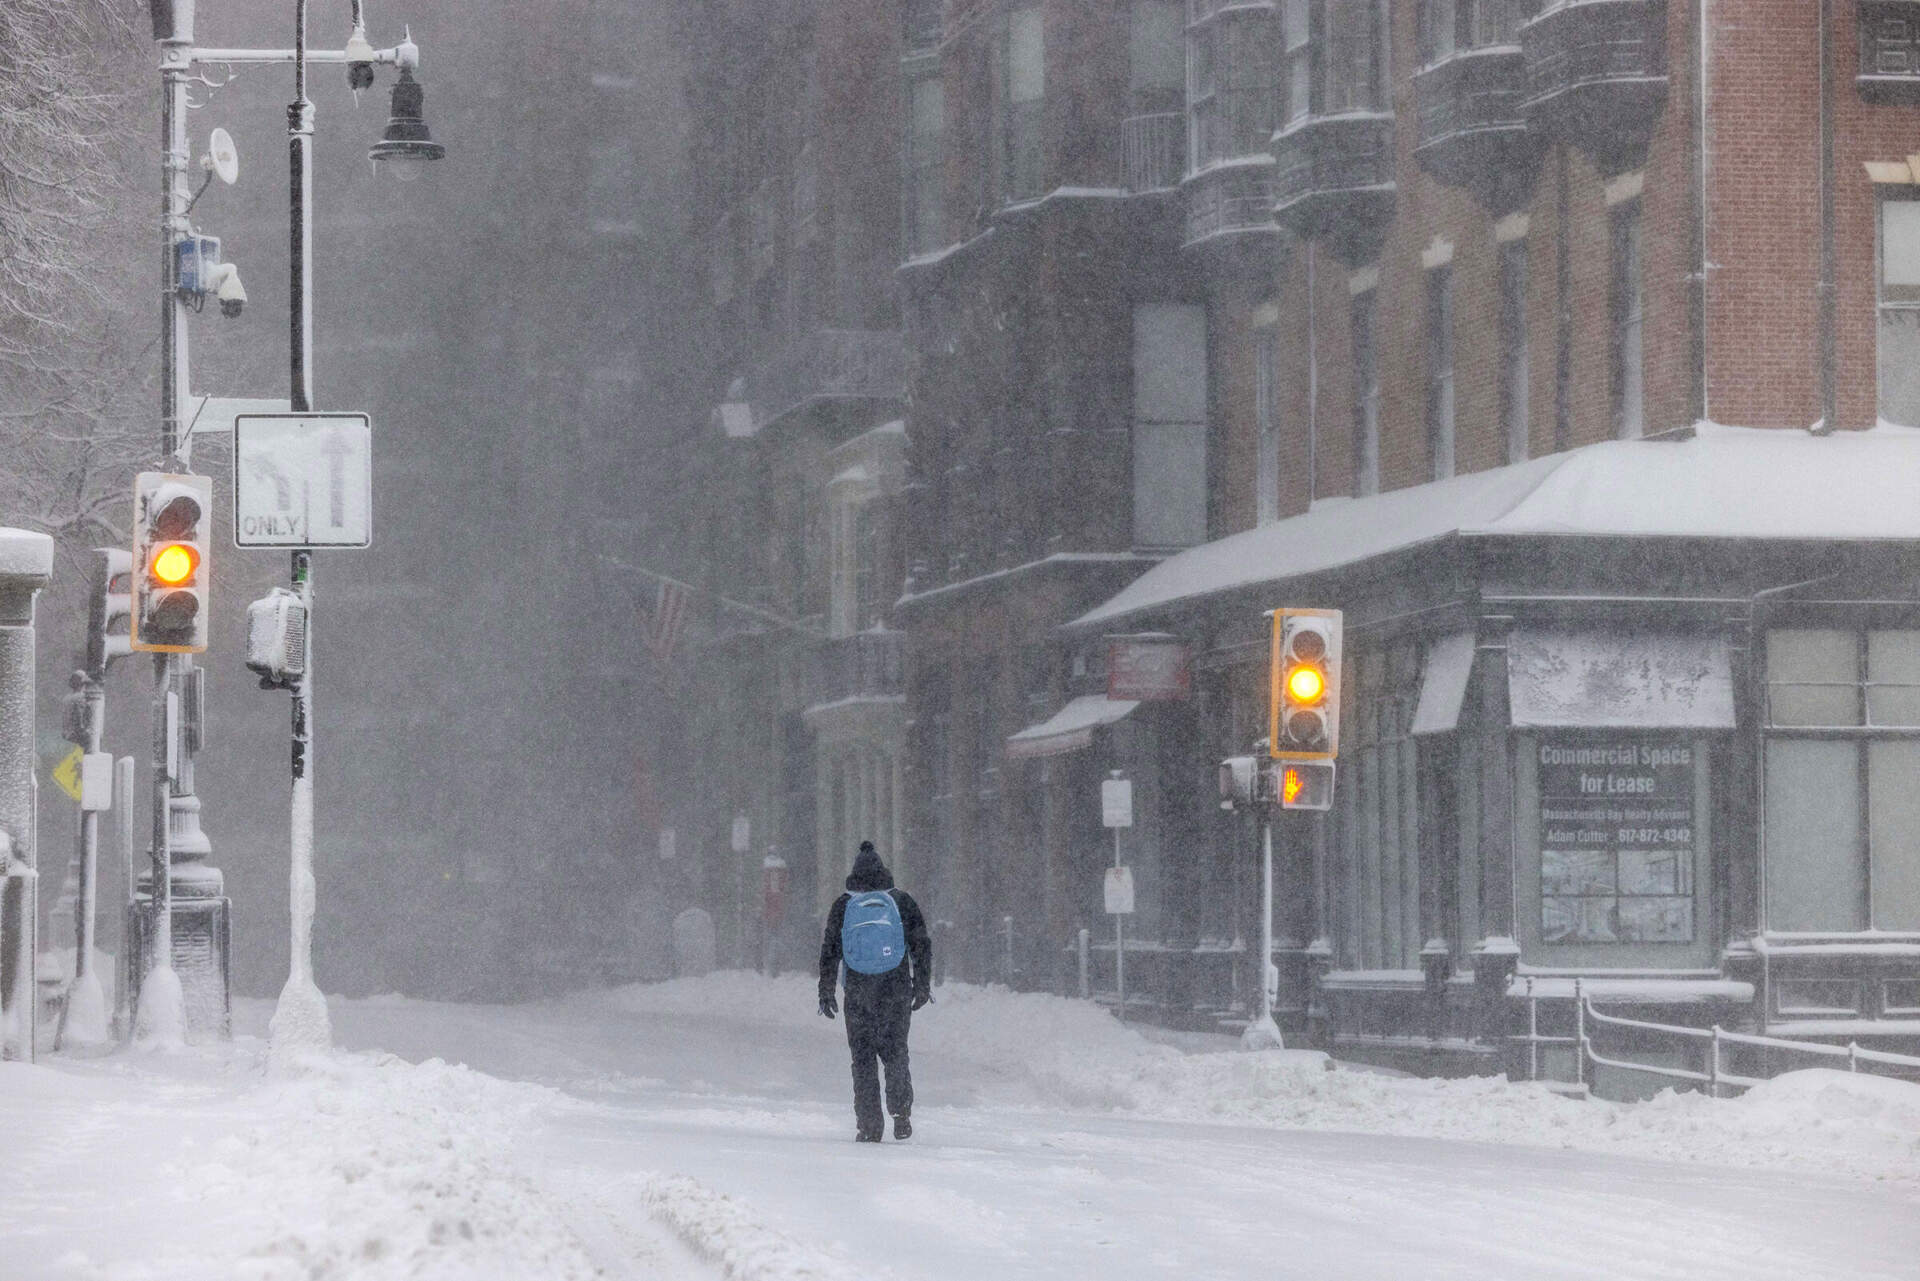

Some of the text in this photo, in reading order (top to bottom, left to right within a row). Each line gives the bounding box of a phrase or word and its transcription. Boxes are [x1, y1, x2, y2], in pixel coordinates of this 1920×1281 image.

[244, 516, 301, 536] ONLY
[1541, 745, 1690, 769] Commercial Space
[1580, 773, 1655, 793] for Lease
[1547, 830, 1576, 842] Adam
[1619, 829, 1690, 842] 617-872-4342
